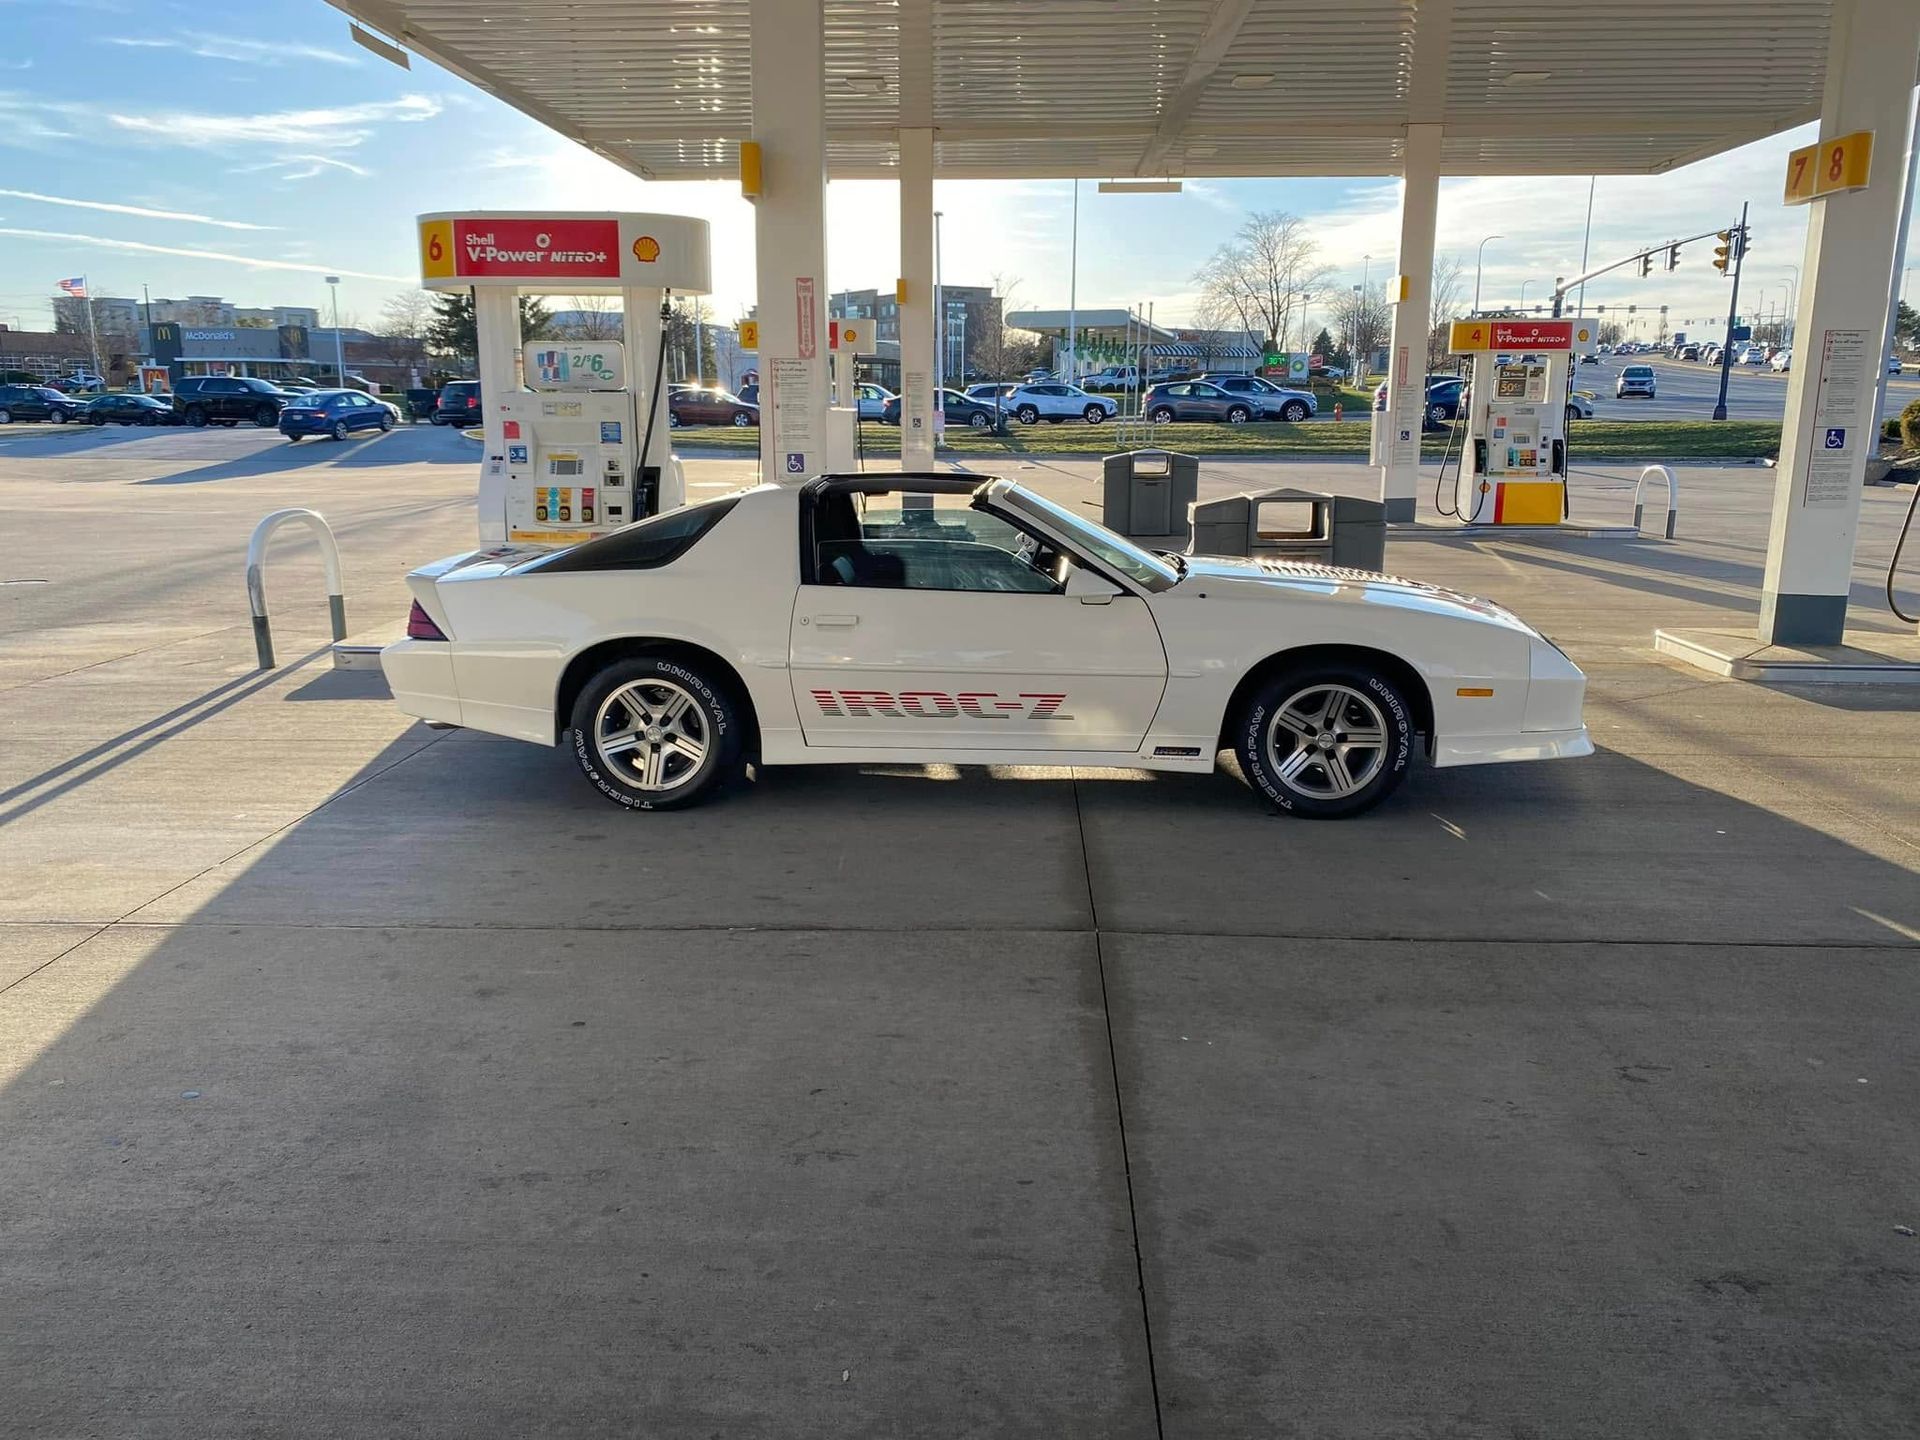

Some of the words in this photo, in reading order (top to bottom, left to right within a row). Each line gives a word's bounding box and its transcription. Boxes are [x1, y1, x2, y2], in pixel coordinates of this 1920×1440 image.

[1792, 156, 1808, 190] 7
[1829, 146, 1844, 182] 8
[428, 233, 443, 262] 6
[465, 233, 495, 246] Shell
[466, 246, 545, 263] V-Power
[185, 331, 235, 341] McDonald's
[746, 327, 755, 341] 2
[1471, 329, 1483, 342] 4
[1496, 335, 1536, 343] V-Power
[656, 661, 728, 736] UNIROYAL
[809, 689, 1075, 721] IROC-Z
[1247, 705, 1266, 750] PAW
[1369, 677, 1409, 772] UNIROYAL
[574, 728, 593, 772] PAW
[597, 779, 653, 809] TIGER
[1251, 762, 1293, 810] TIGER
